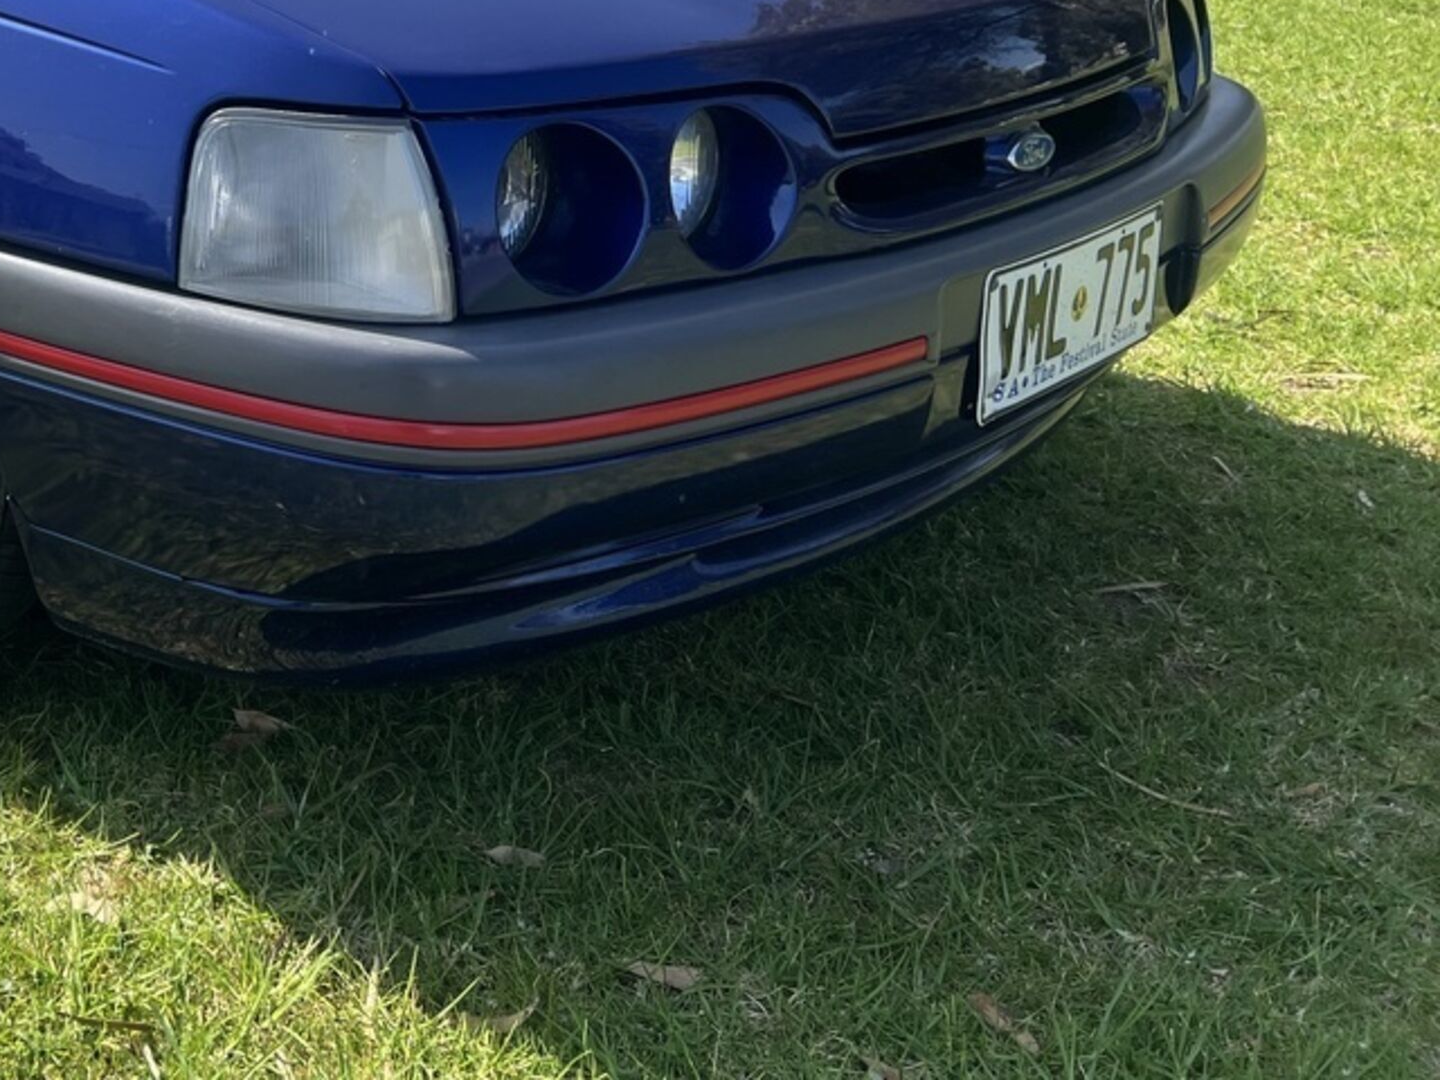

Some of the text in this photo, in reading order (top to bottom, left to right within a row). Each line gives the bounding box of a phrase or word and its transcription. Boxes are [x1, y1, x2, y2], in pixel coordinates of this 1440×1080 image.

[999, 221, 1155, 380] VML 775
[1031, 363, 1057, 387] The
[1058, 335, 1108, 373] Festival
